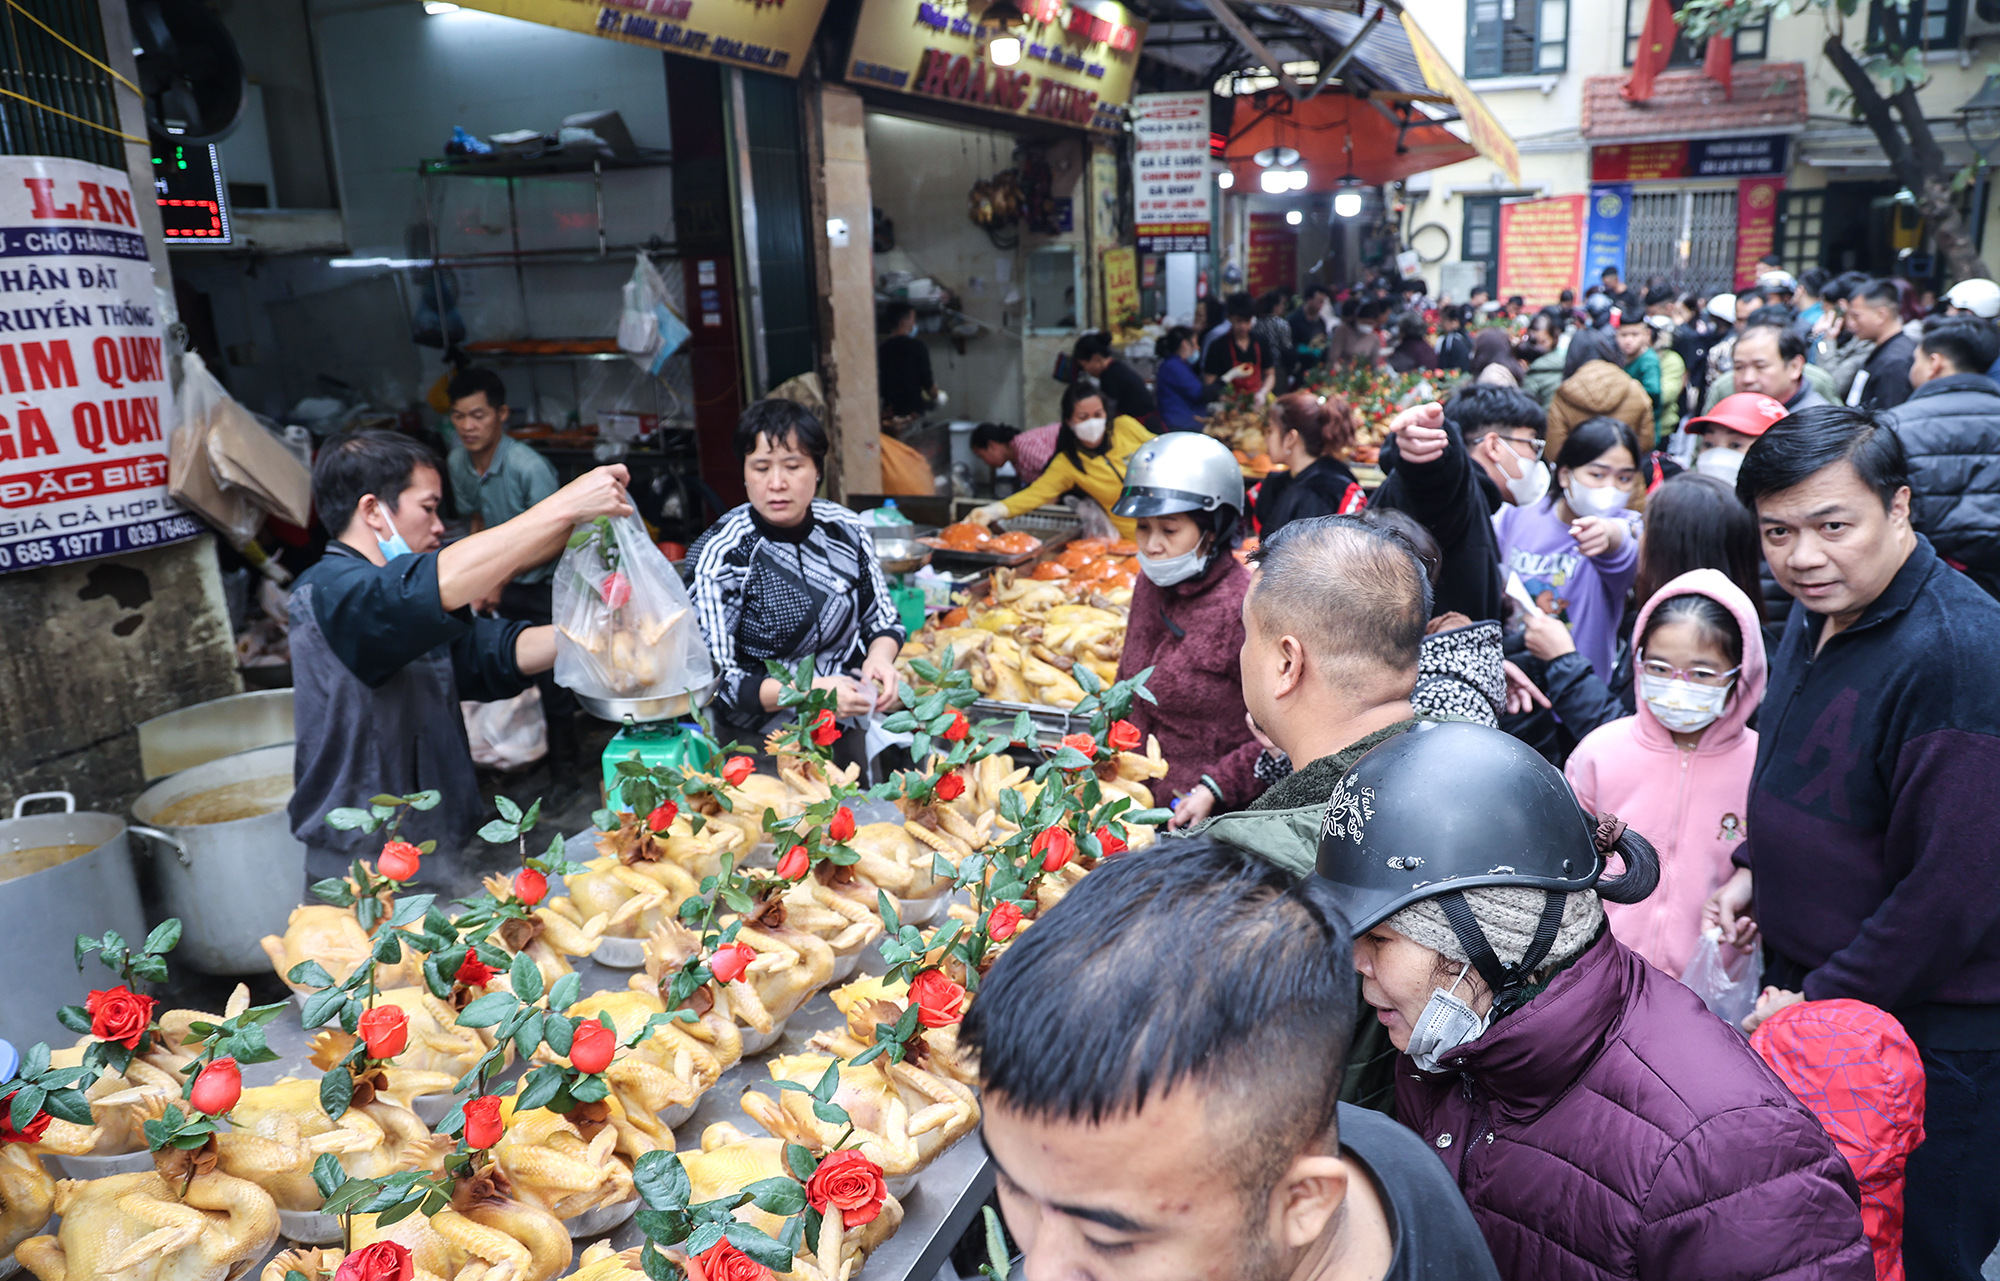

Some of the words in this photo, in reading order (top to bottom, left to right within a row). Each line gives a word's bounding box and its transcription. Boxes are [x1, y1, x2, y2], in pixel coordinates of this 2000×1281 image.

[23, 178, 137, 229] LAN
[25, 231, 73, 254] CHỢ
[97, 298, 155, 327] THỐNG
[92, 335, 165, 389] QUAY
[72, 397, 163, 454] QUAY
[0, 471, 95, 502] ĐẶC
[102, 458, 168, 487] BIỆT
[0, 512, 52, 538] GIÁ
[58, 504, 102, 528] CẢ
[15, 540, 56, 565] 685
[57, 531, 104, 557] 1977
[127, 525, 158, 546] 039
